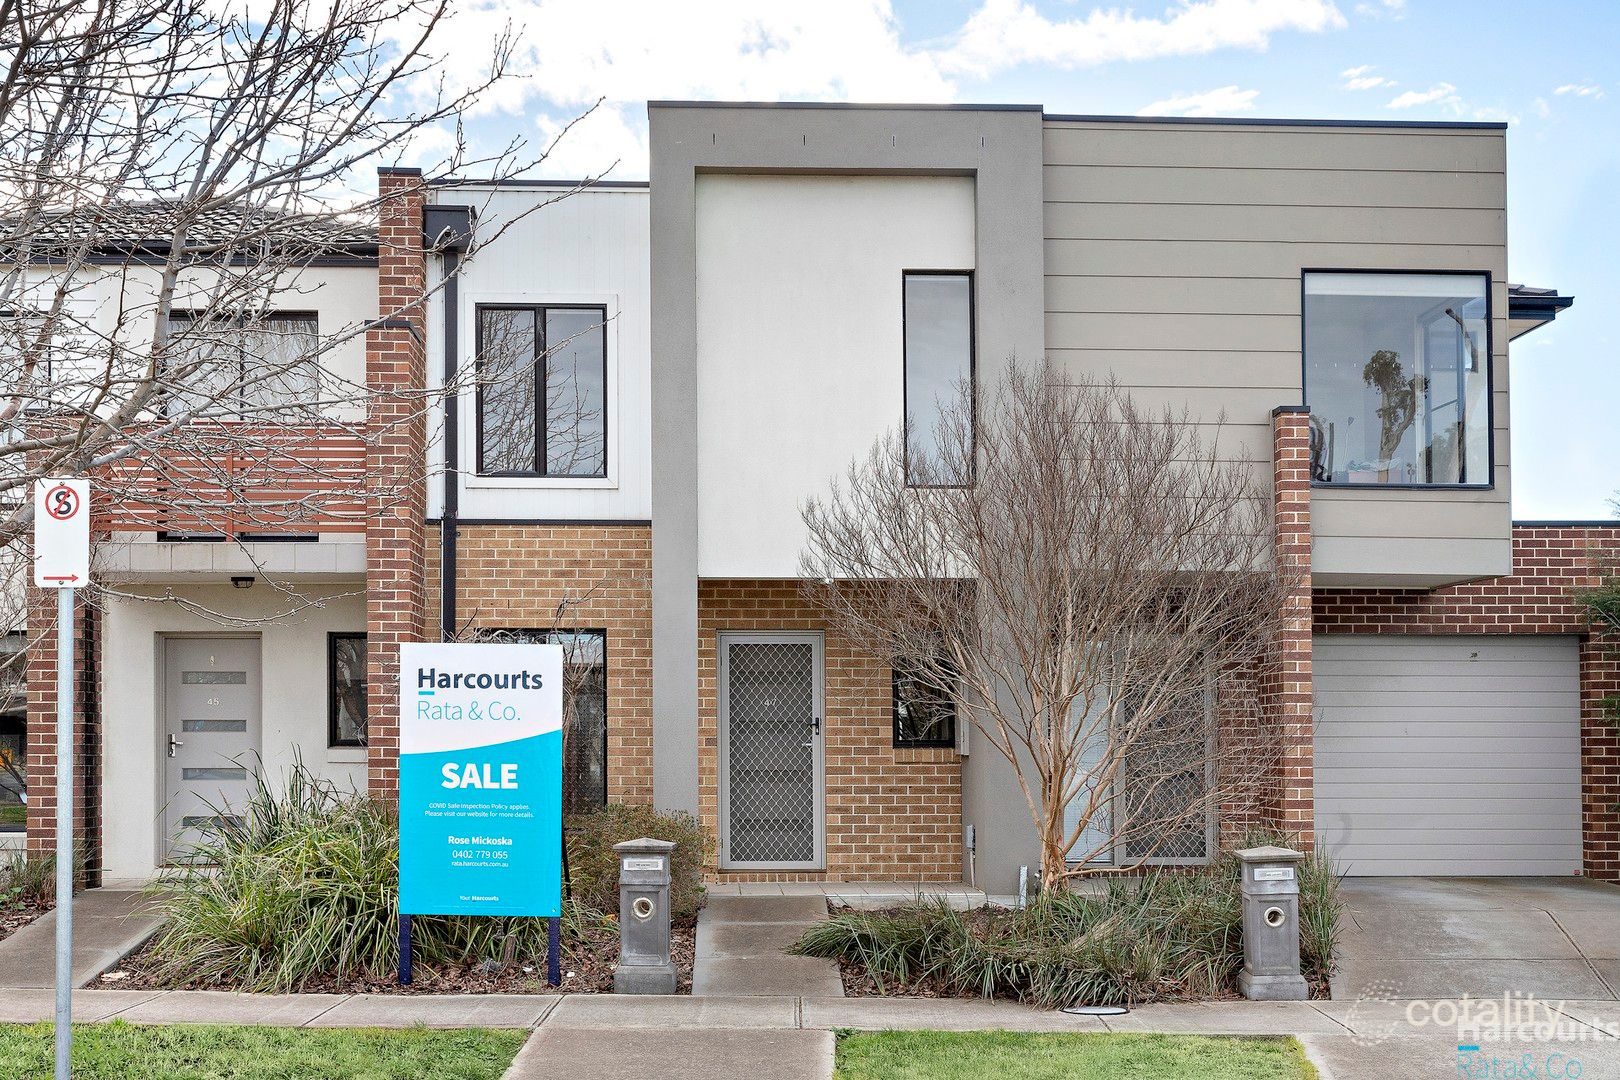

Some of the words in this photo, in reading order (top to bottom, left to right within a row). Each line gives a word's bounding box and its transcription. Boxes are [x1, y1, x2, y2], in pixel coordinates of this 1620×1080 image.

[418, 667, 543, 690] Harcourts
[417, 700, 462, 720] Rata
[468, 701, 483, 720] &
[488, 701, 521, 721] Co.
[441, 762, 519, 790] SALE
[491, 803, 508, 811] Policy
[448, 835, 470, 845] Rose
[471, 836, 513, 846] Mickoska
[452, 850, 473, 859] 0402
[475, 850, 491, 859] 779
[492, 851, 508, 860] 055
